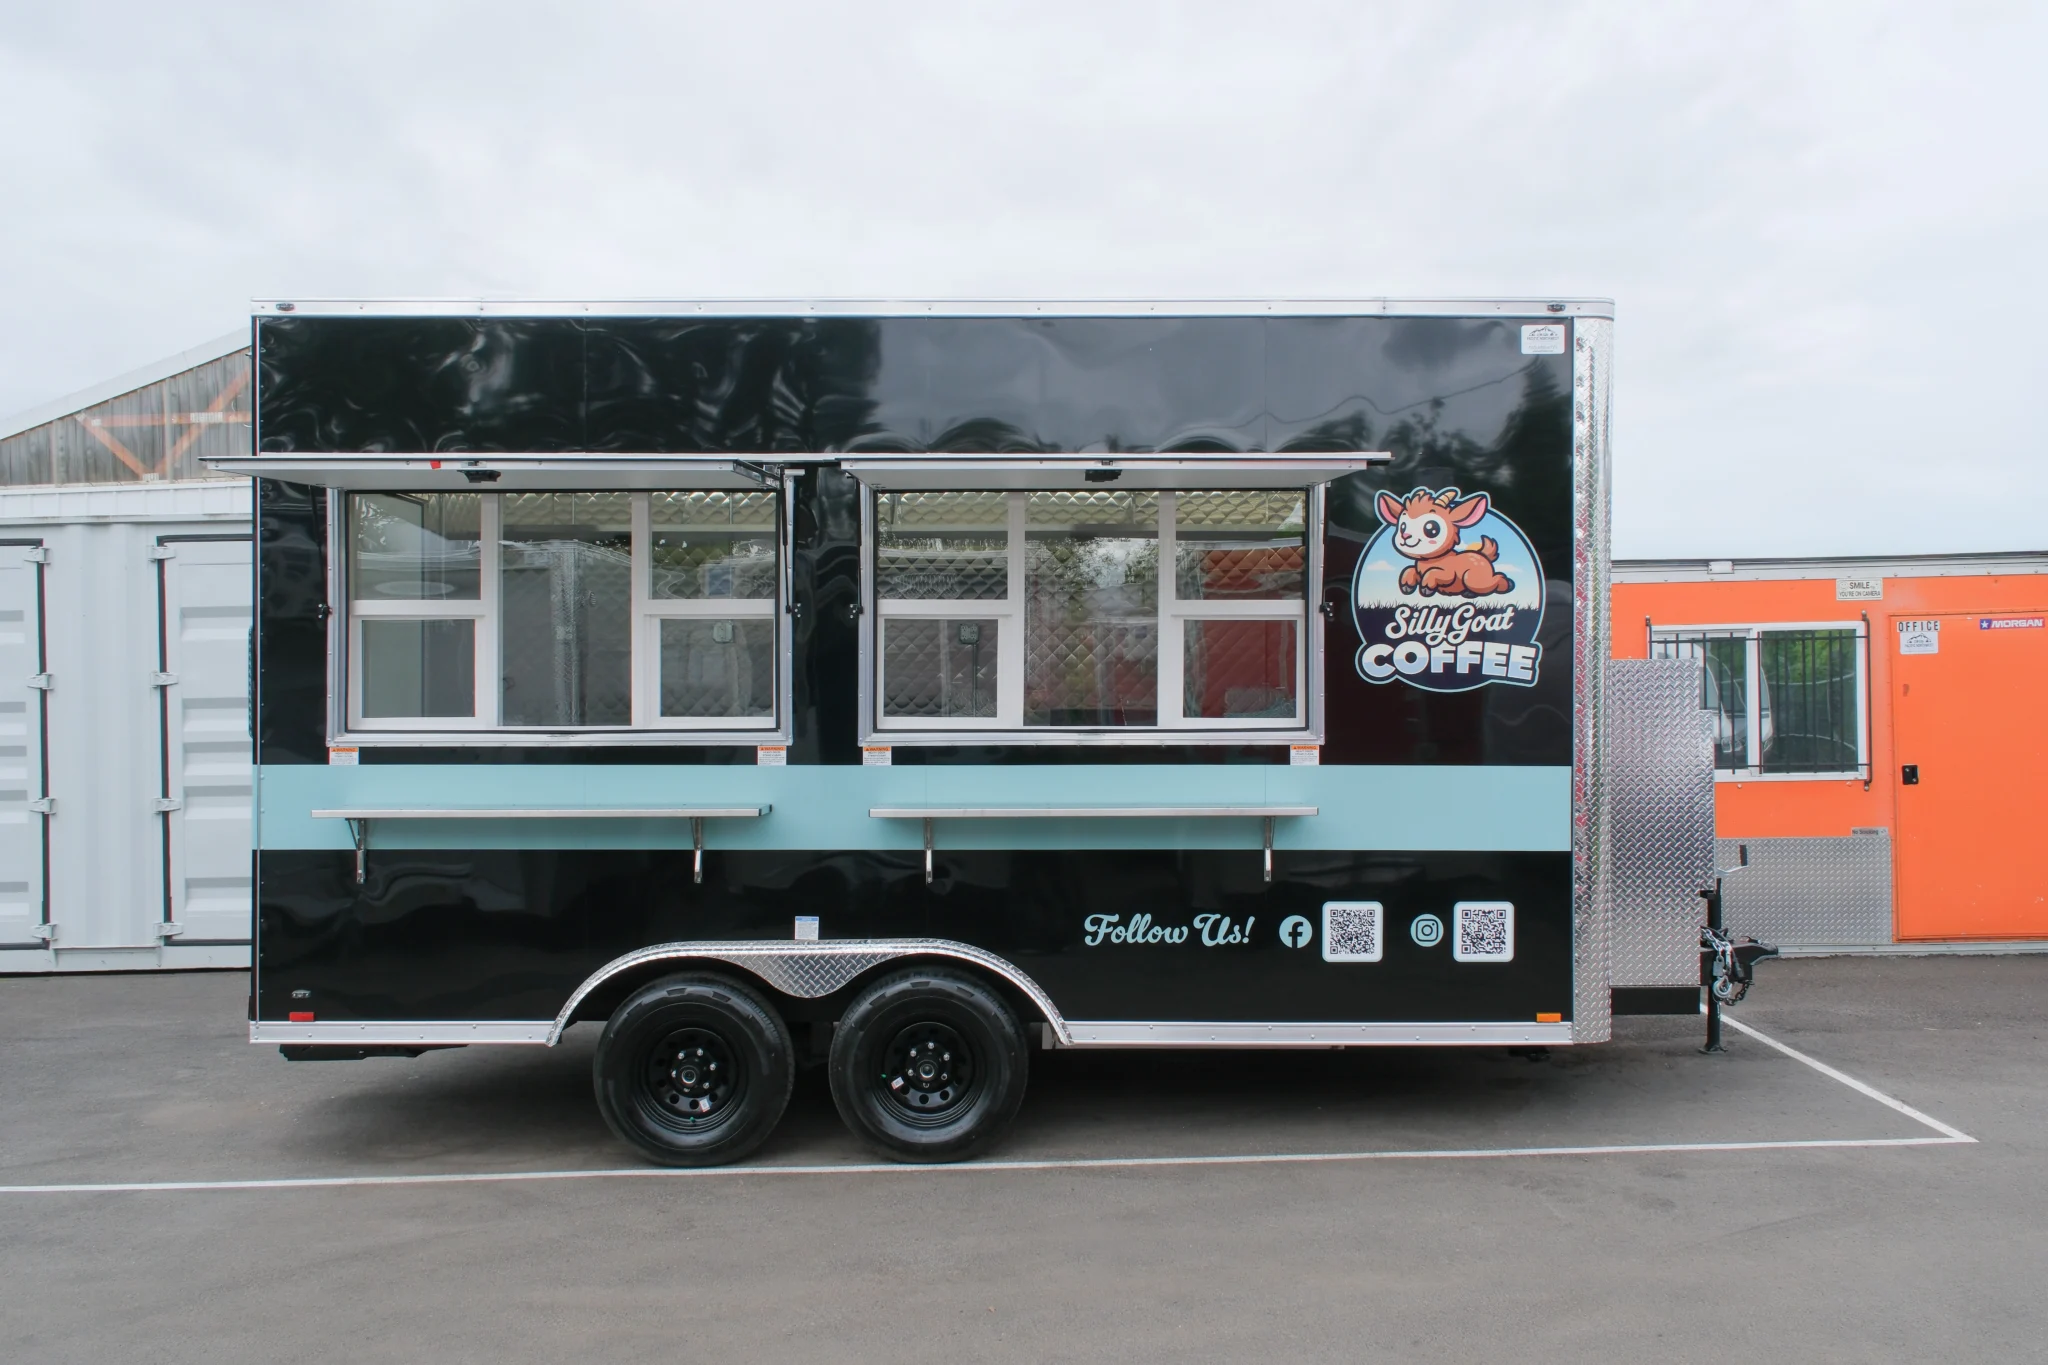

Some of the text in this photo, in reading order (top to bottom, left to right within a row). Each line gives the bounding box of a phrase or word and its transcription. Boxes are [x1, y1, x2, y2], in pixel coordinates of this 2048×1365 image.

[1849, 581, 1870, 590] SMILE
[1385, 604, 1515, 646] Silly Goat
[1898, 620, 1939, 632] OFFICE
[1991, 618, 2044, 628] MORGAN
[1362, 641, 1537, 681] COFFEE
[1084, 913, 1256, 947] Follow Us!
